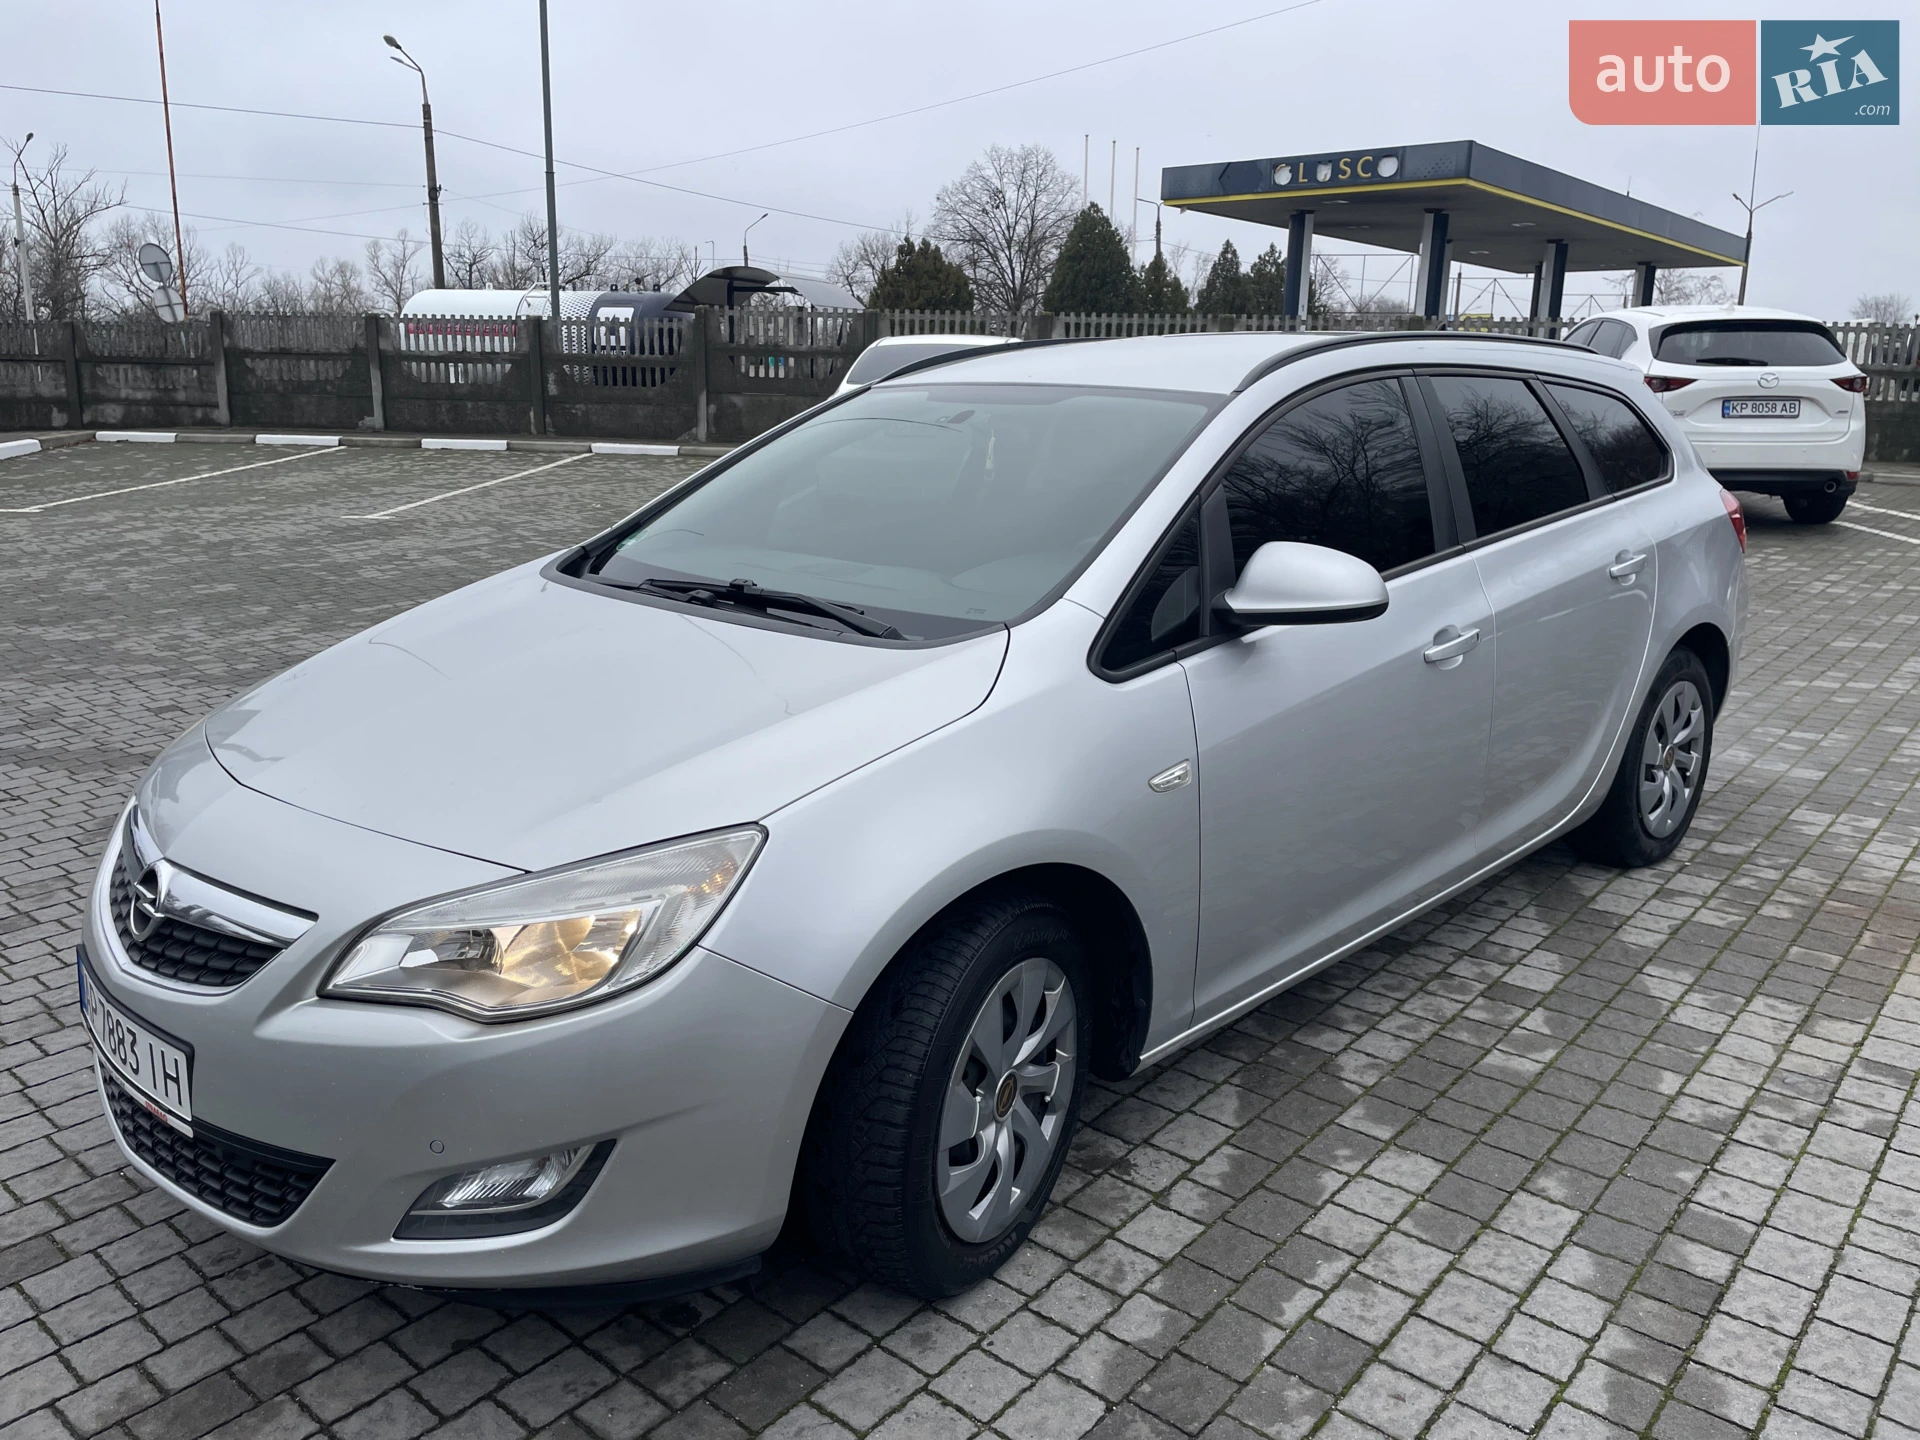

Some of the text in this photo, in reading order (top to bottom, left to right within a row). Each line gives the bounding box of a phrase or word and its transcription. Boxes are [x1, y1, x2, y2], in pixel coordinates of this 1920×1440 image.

[1731, 402, 1797, 414] KP 8058 AB
[98, 996, 139, 1076] 7883
[148, 1040, 183, 1108] IH
